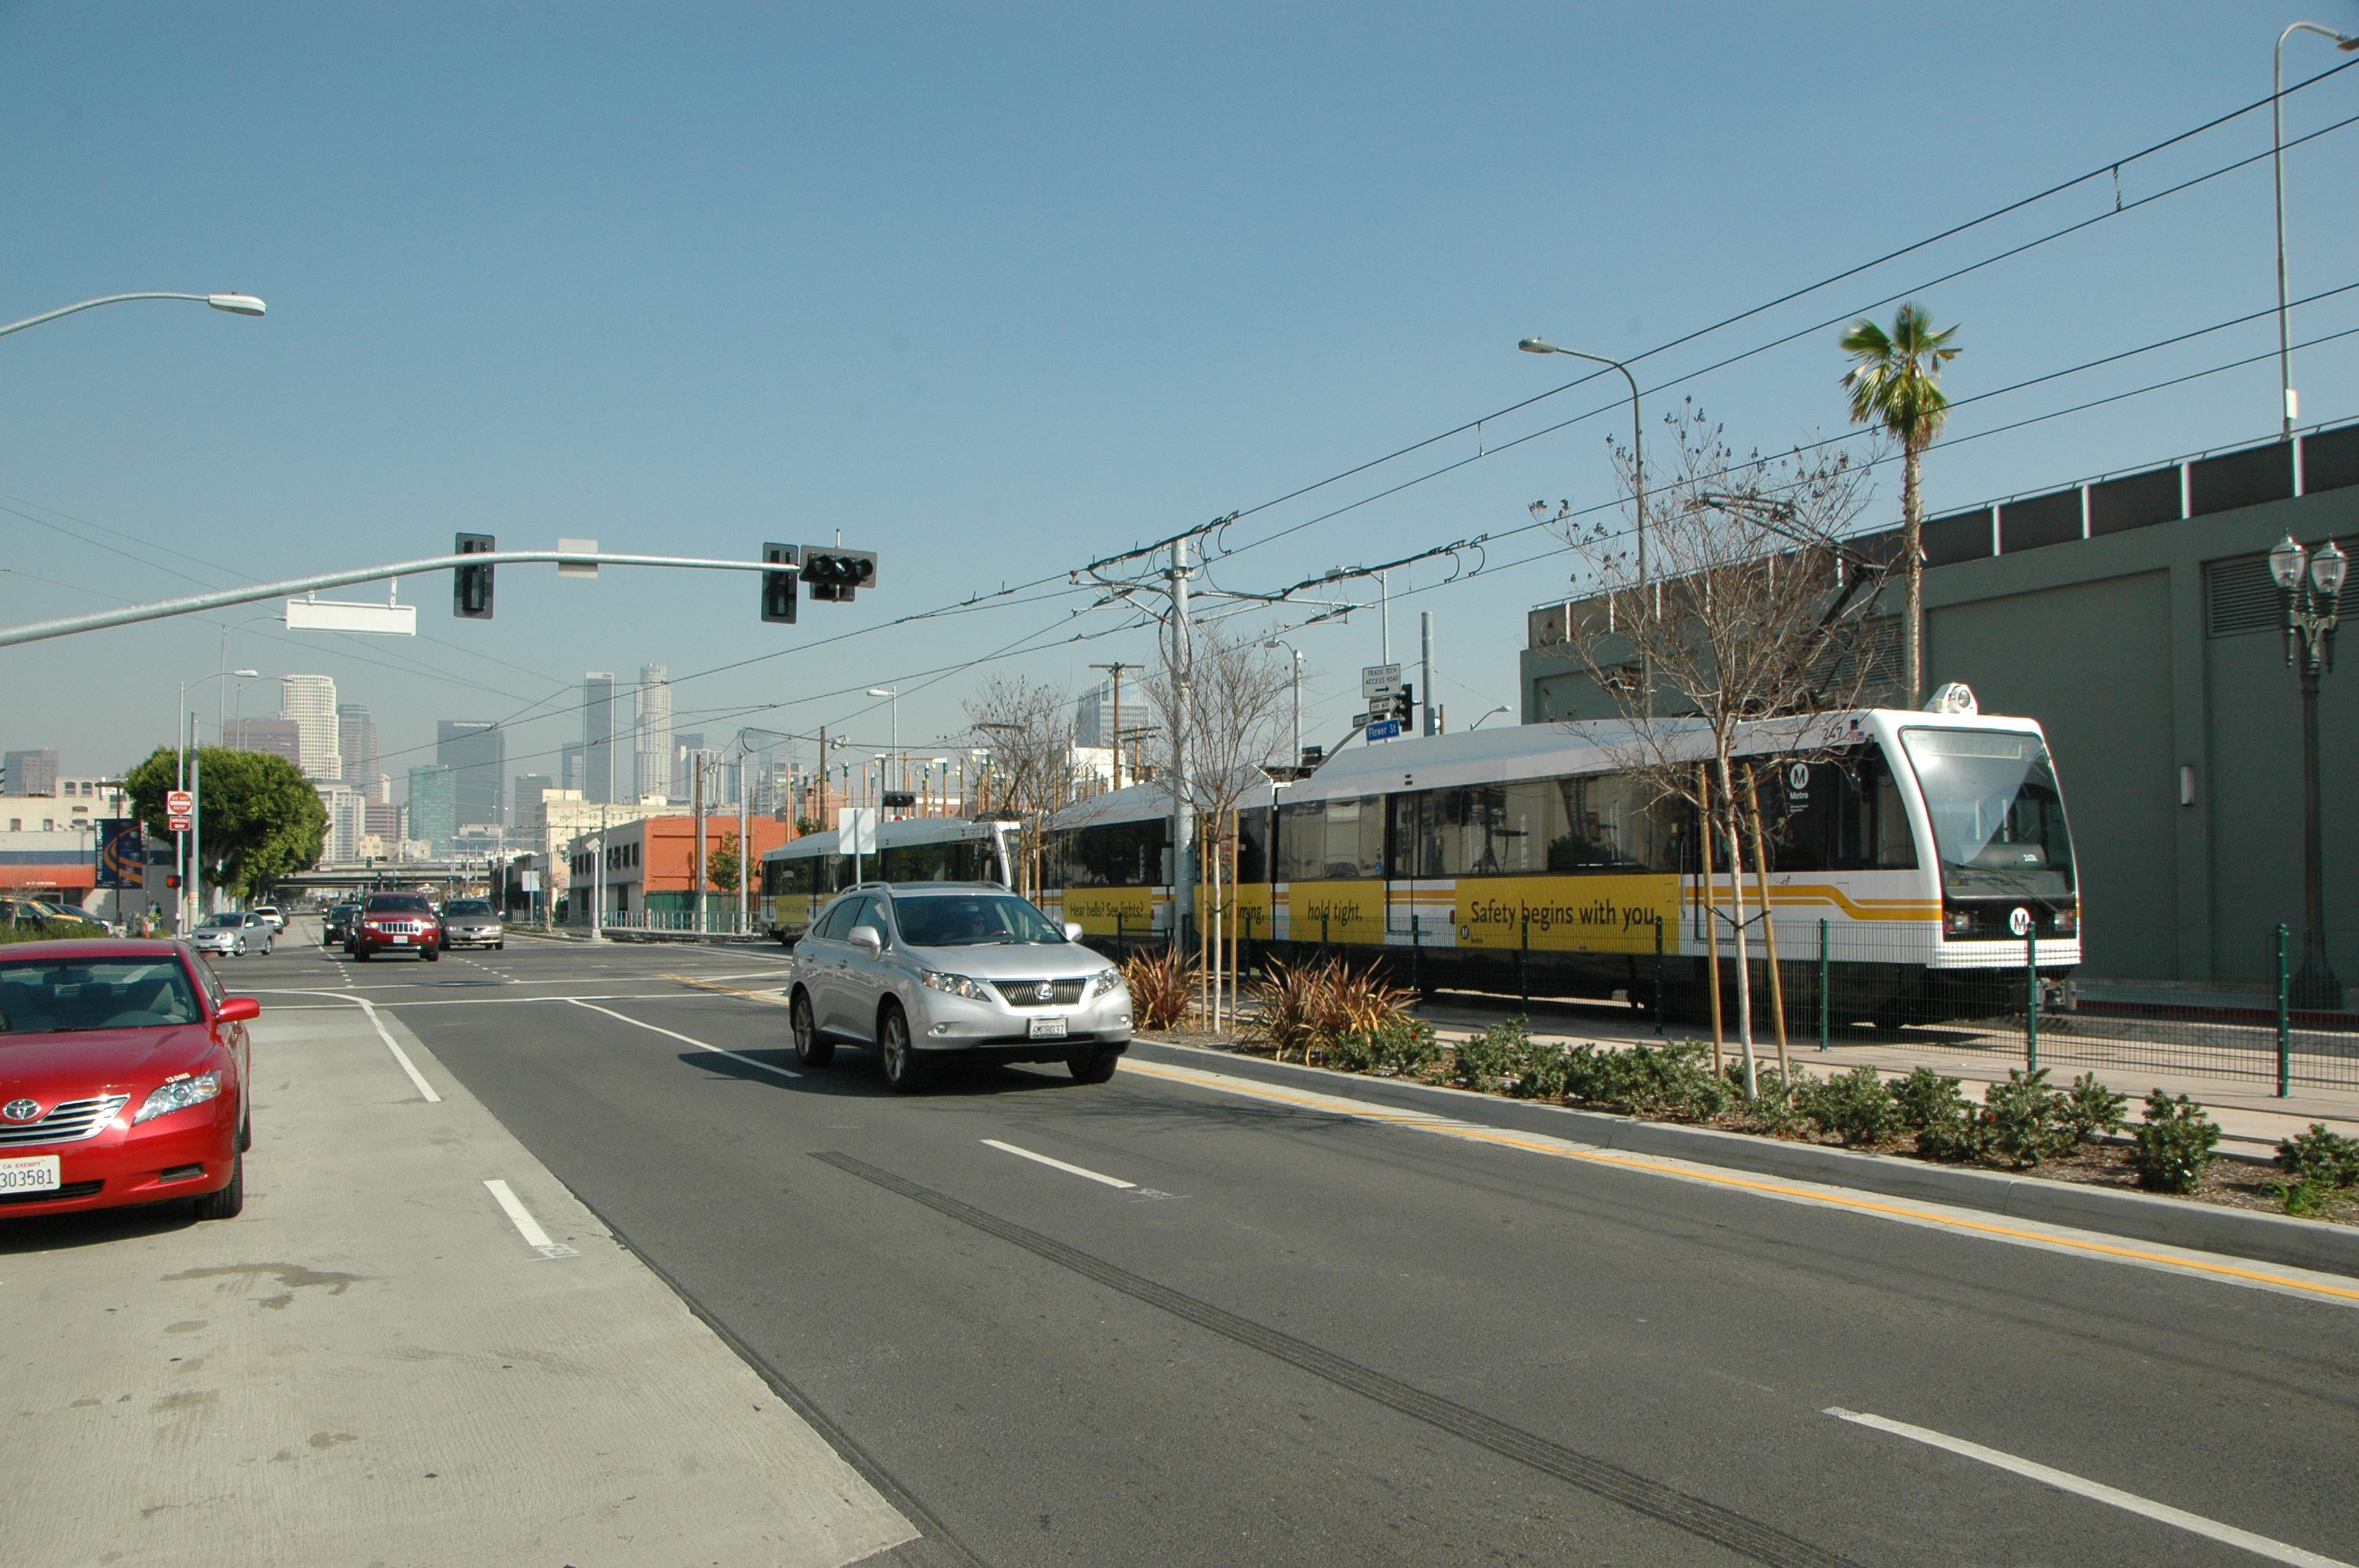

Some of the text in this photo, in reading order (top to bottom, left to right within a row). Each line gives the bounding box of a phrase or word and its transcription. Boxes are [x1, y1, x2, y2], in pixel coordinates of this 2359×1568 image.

[1369, 723, 1396, 738] Flower St
[1070, 901, 1143, 922] Hear bells? See lights?
[1307, 898, 1363, 927] hold tight.
[1470, 898, 1517, 931] Safety
[1521, 898, 1573, 931] begins
[1579, 898, 1616, 924] with
[0, 1168, 54, 1188] 303581
